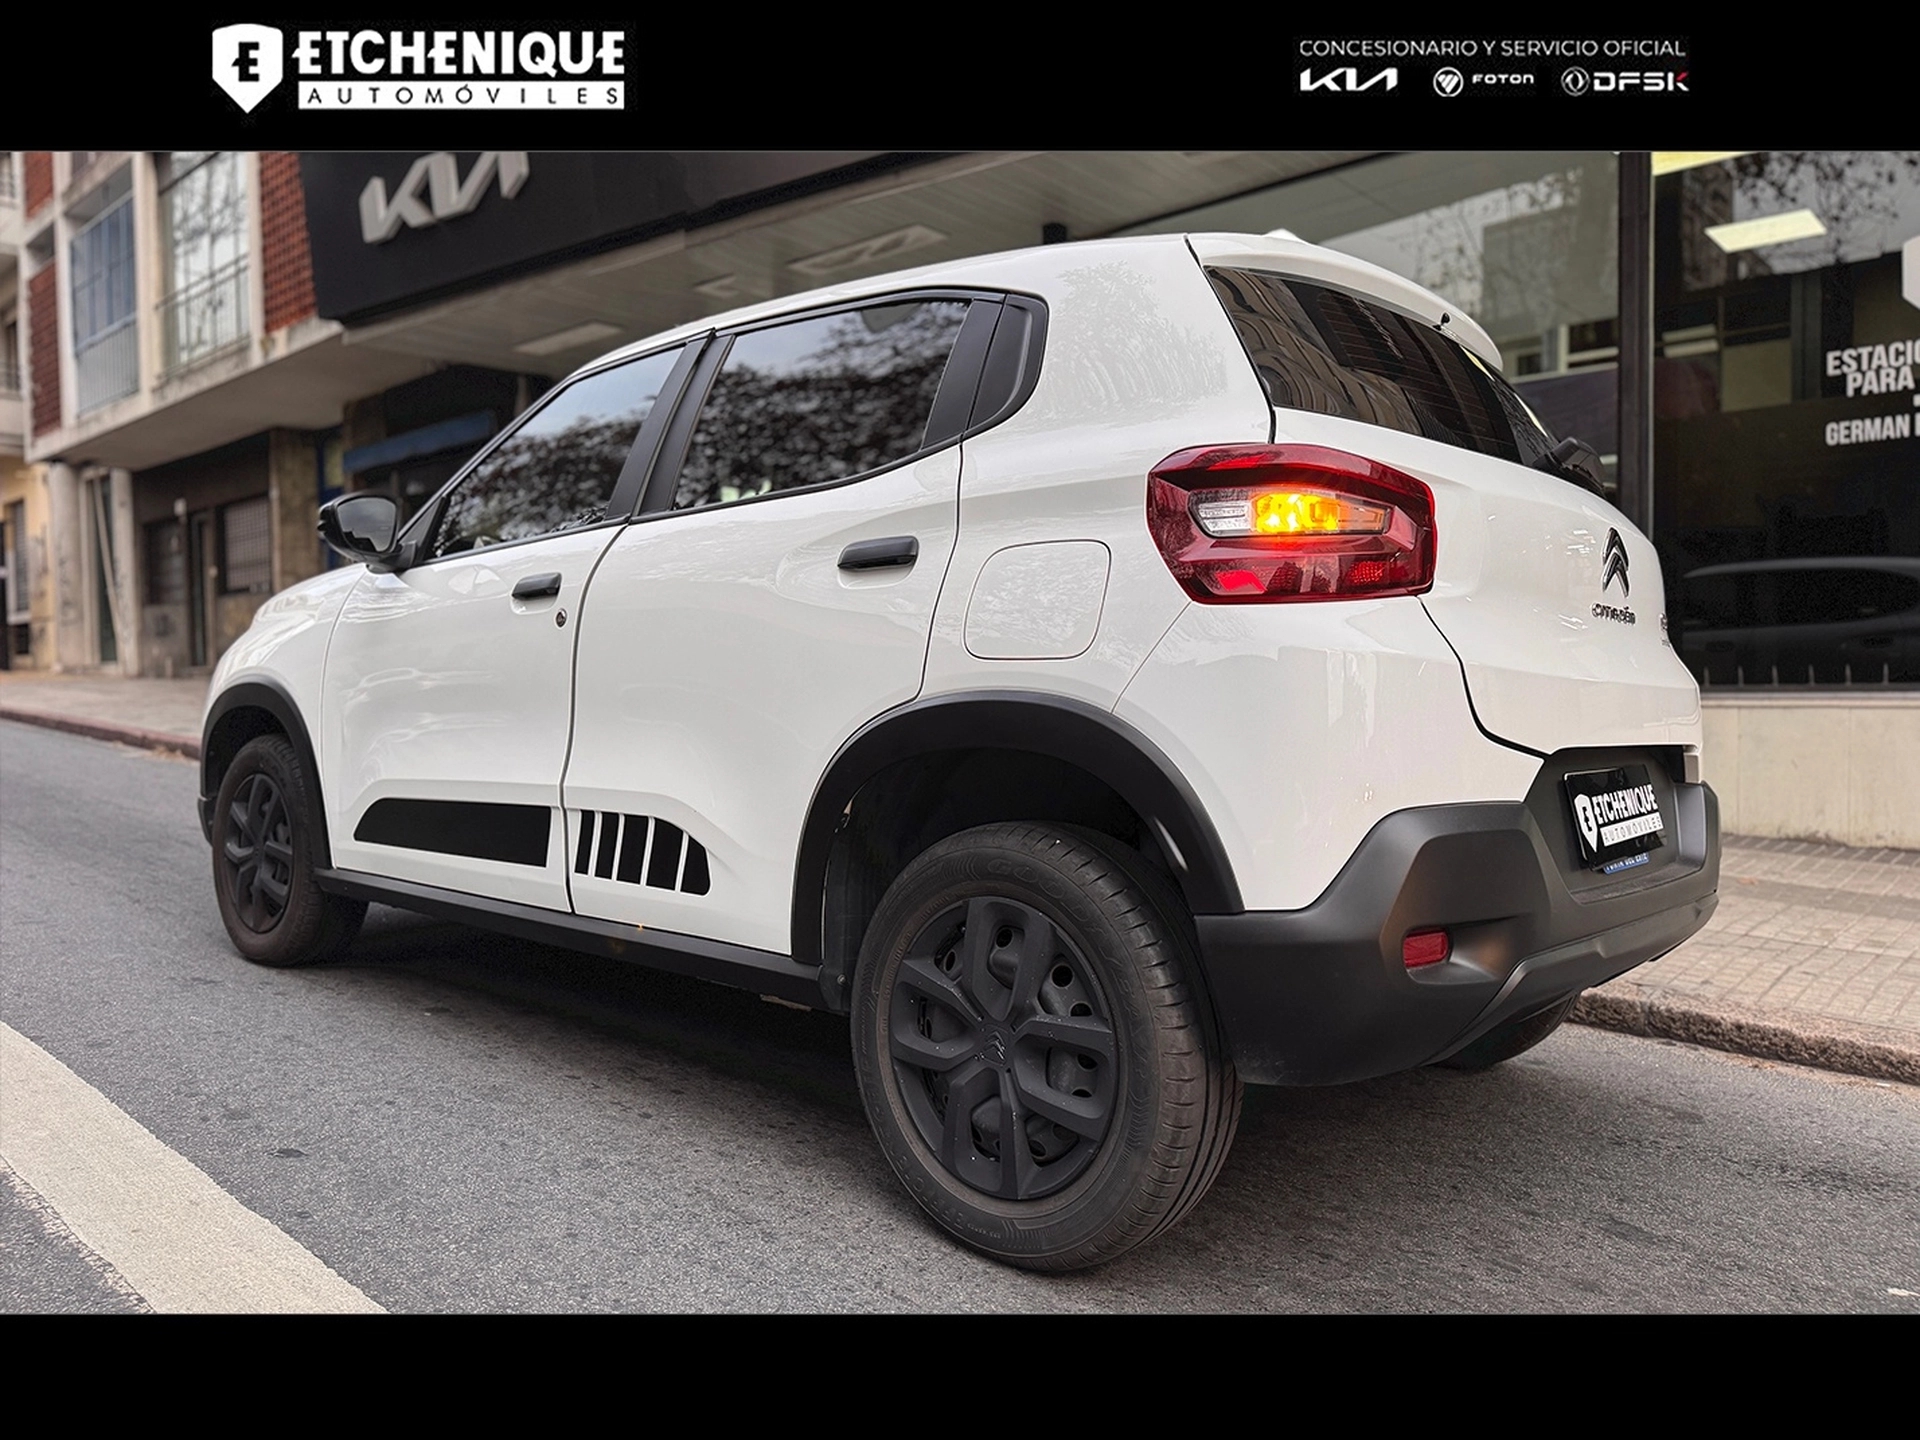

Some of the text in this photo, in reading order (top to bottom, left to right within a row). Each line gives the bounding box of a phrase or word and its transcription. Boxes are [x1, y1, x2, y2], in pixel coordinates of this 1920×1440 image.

[358, 151, 530, 244] KIA
[1846, 365, 1916, 398] PARA
[1825, 413, 1911, 446] GERMAN
[1591, 784, 1658, 825] ETCHENIQUE
